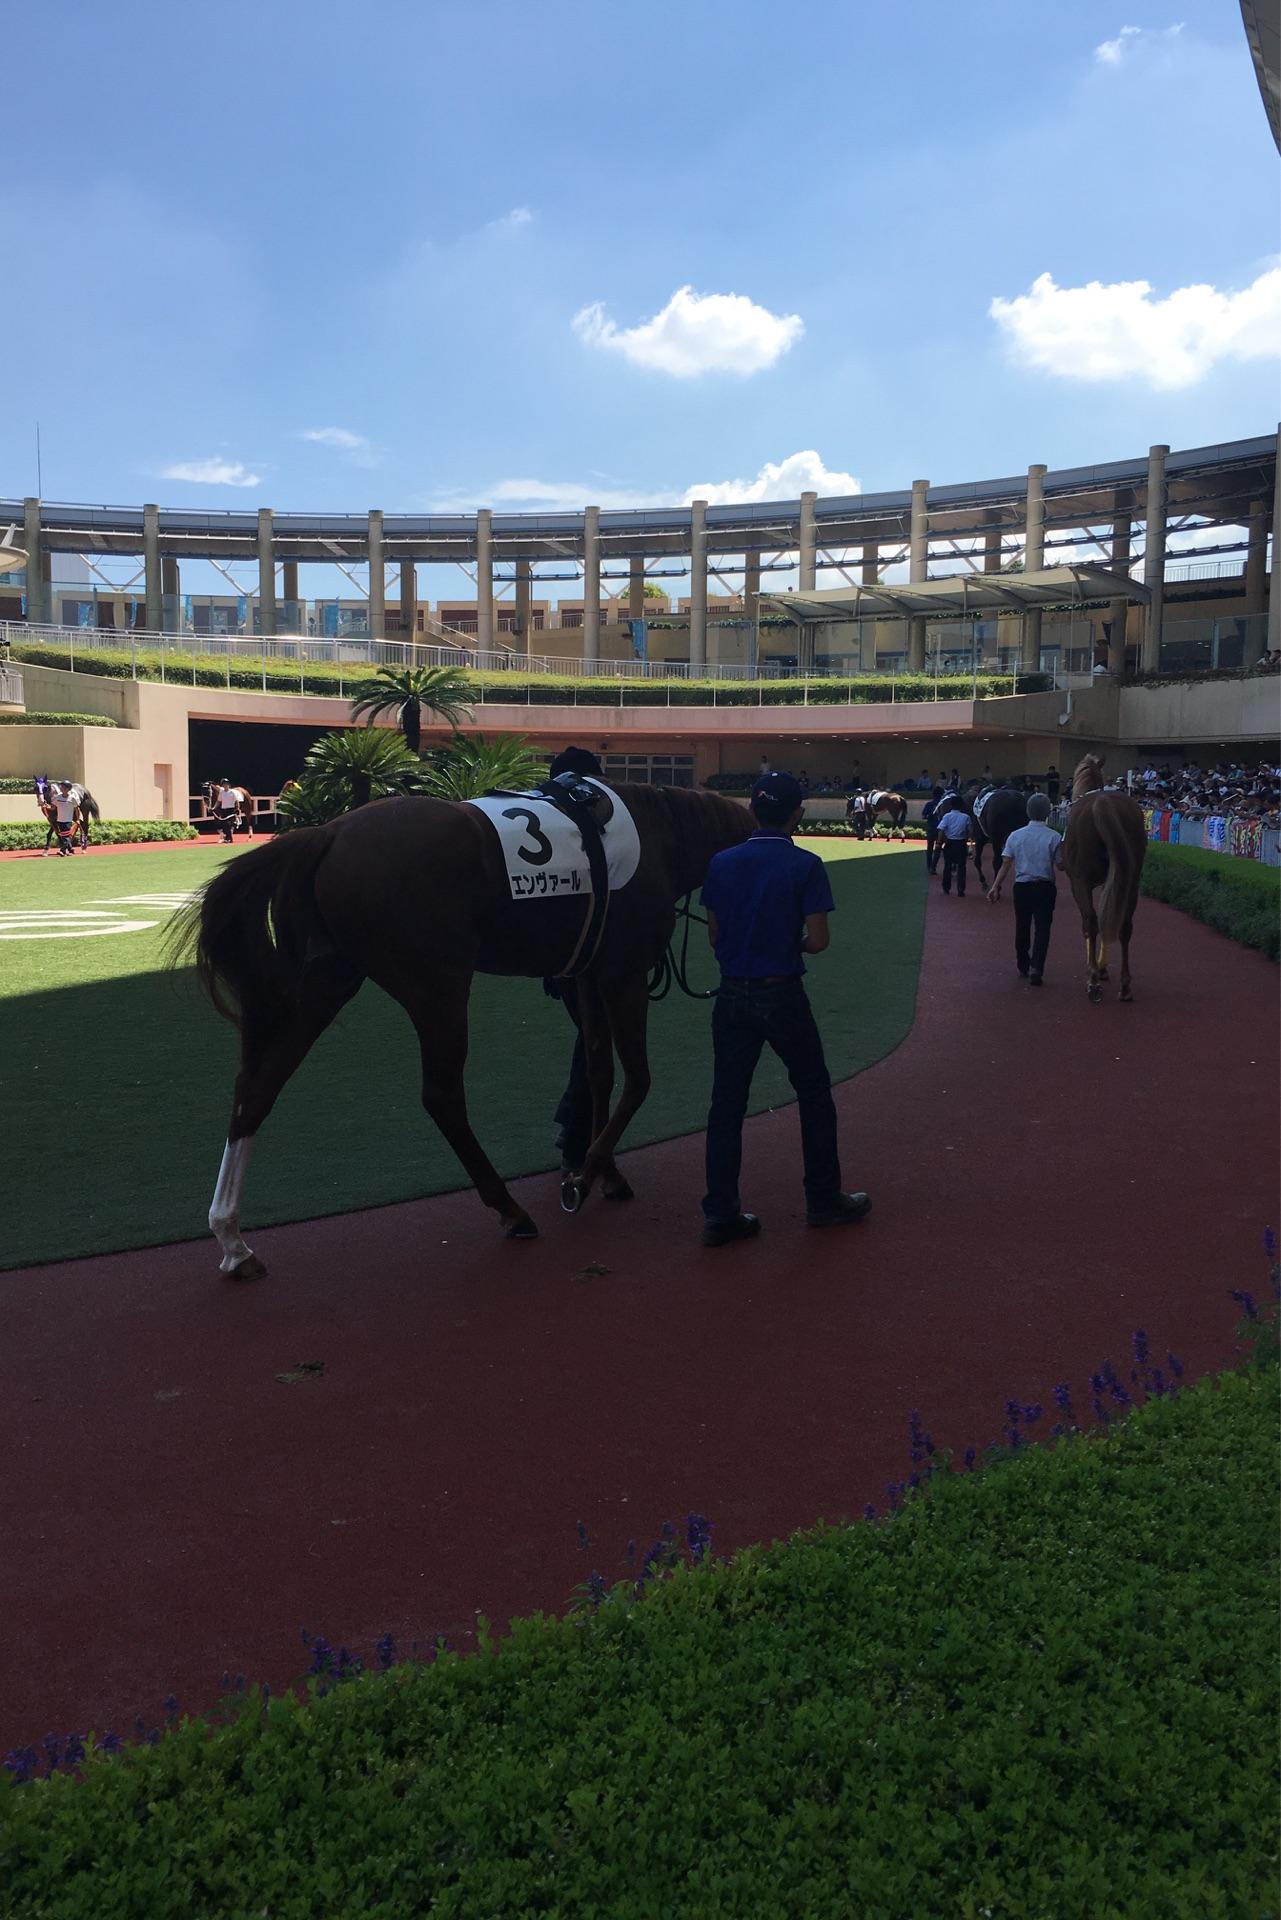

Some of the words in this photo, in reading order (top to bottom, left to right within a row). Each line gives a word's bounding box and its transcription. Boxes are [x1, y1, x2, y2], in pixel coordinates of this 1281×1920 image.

[502, 807, 553, 866] 3
[511, 870, 581, 895] エンヴァール
